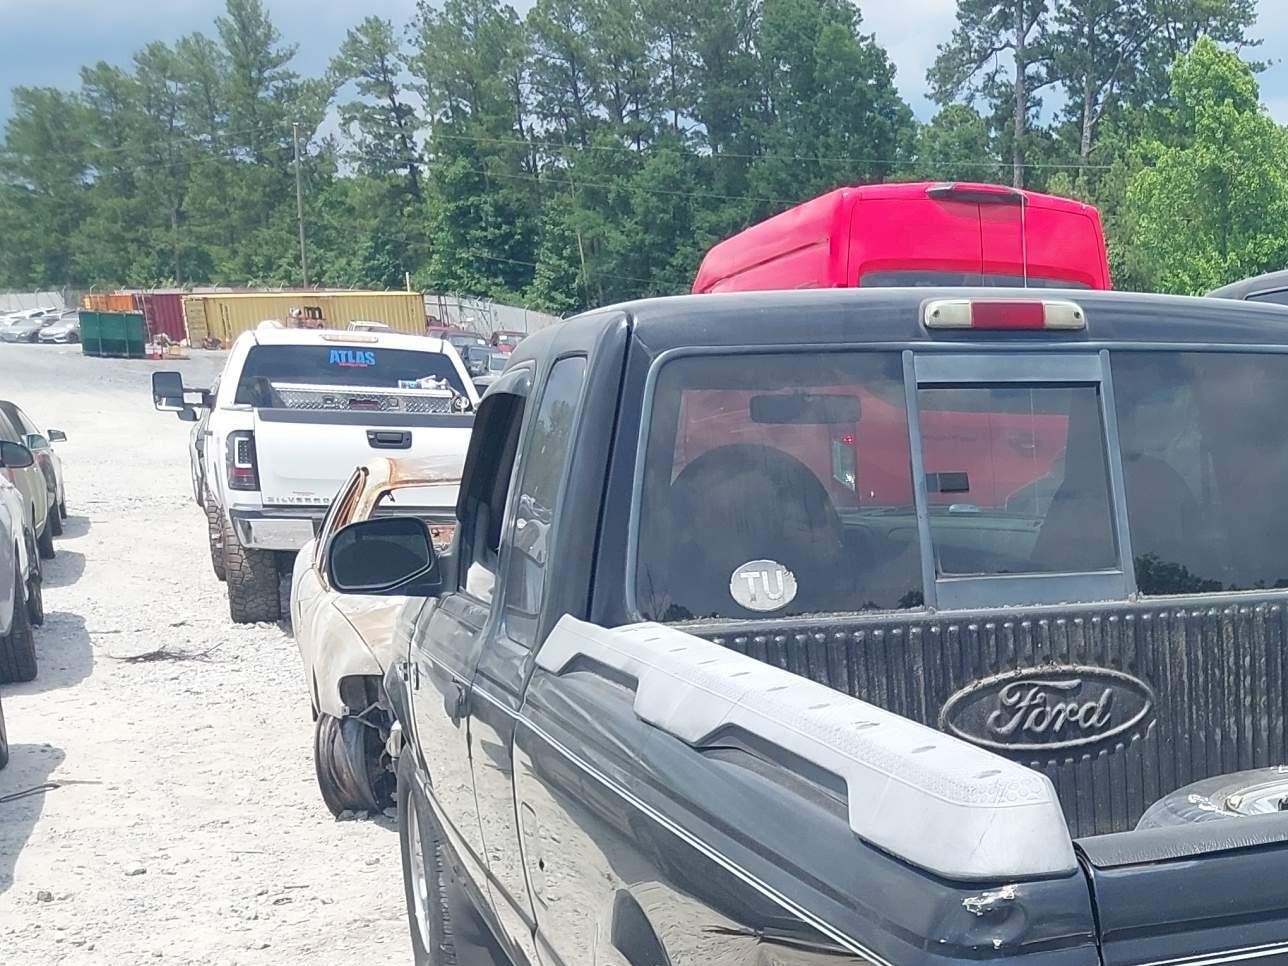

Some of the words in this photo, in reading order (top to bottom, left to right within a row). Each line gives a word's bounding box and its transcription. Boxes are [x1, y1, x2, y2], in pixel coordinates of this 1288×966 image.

[329, 349, 376, 366] ATLAS
[740, 570, 784, 603] TU
[986, 679, 1113, 734] Ford
